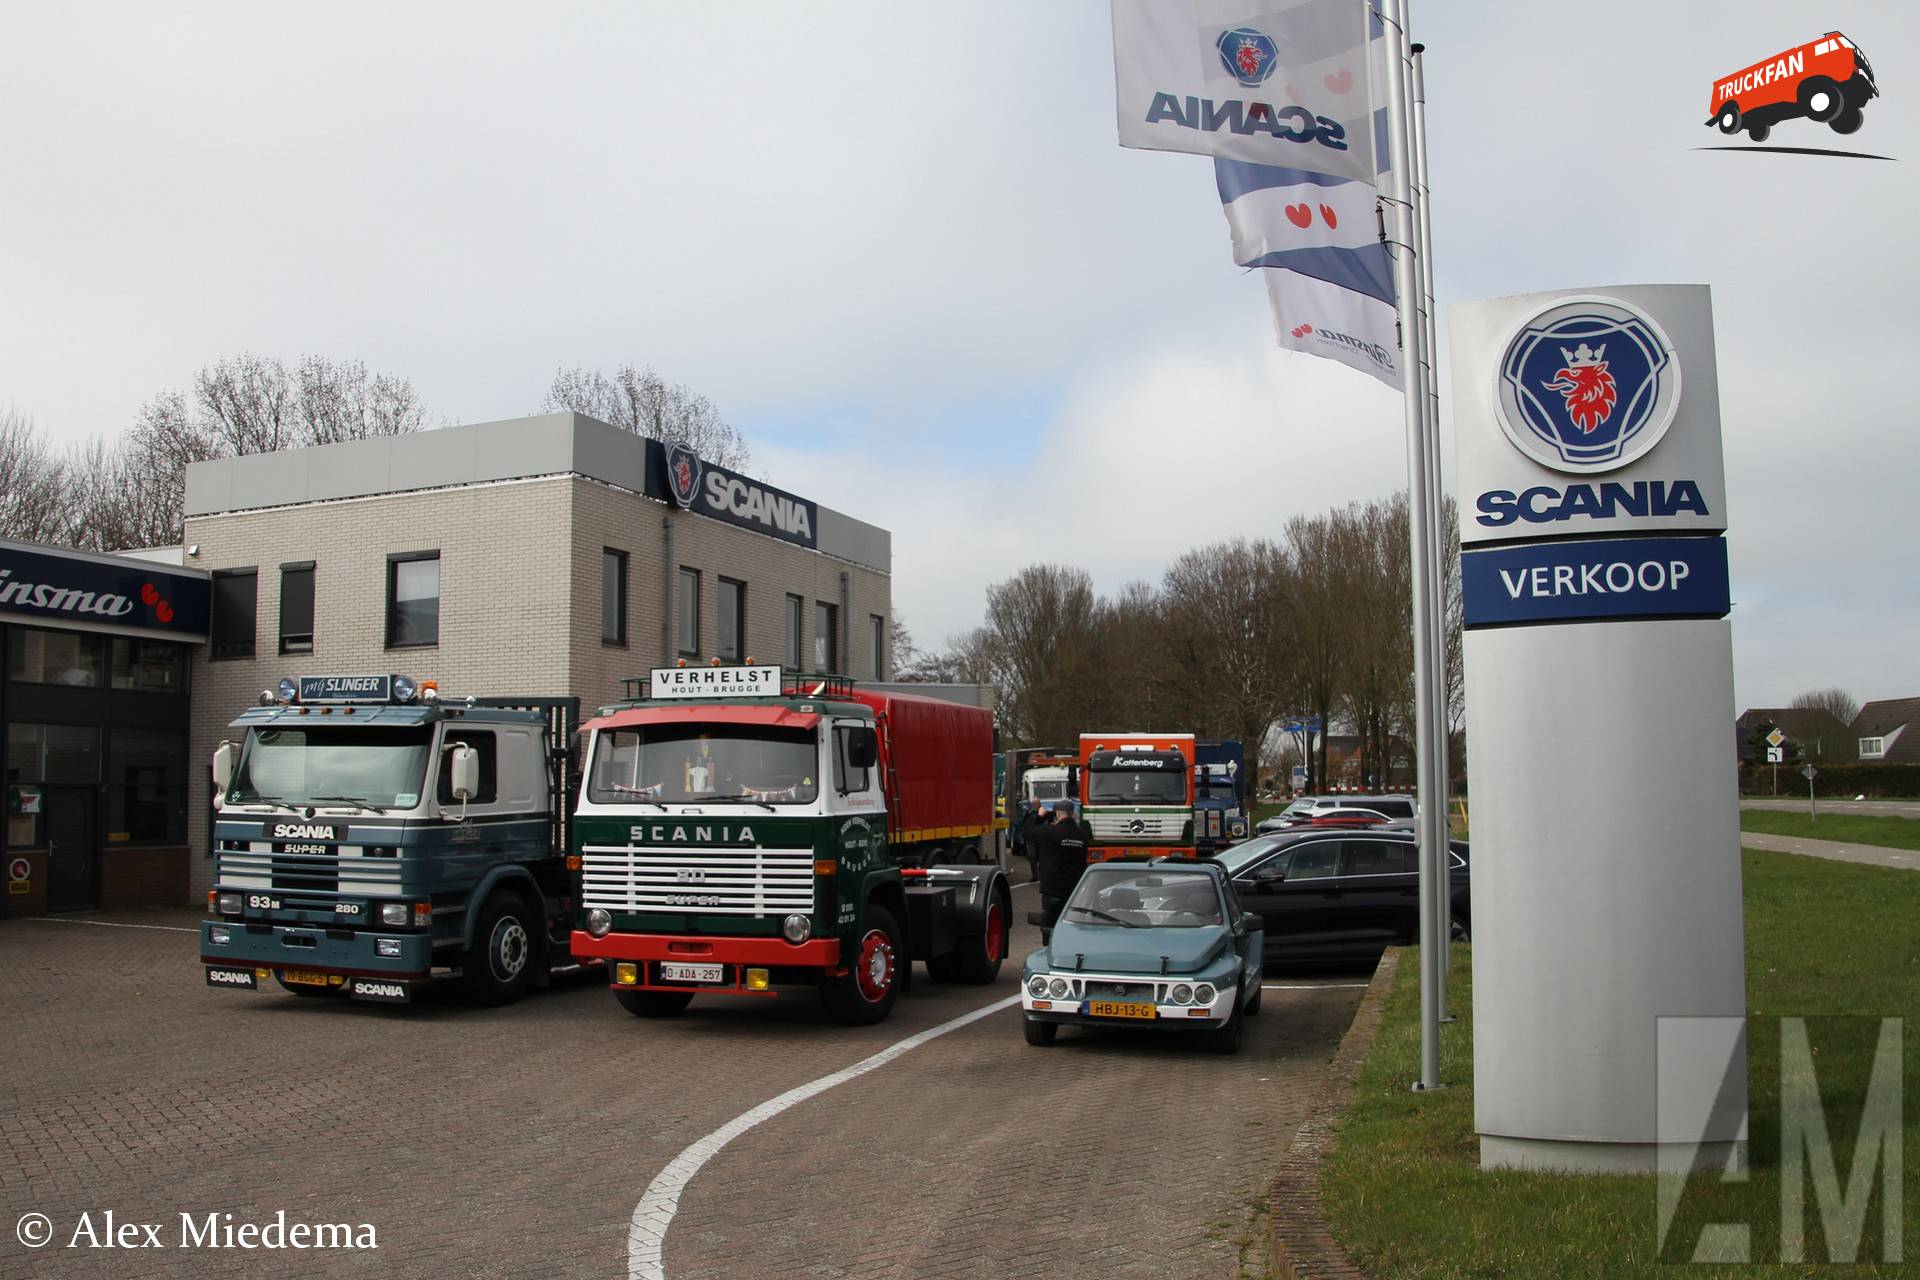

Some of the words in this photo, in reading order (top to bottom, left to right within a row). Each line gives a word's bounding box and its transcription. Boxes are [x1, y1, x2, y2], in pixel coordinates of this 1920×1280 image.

[705, 471, 812, 540] SCANIA
[1475, 480, 1710, 527] SCANIA
[1499, 560, 1690, 600] VERKOOP
[660, 670, 772, 684] VERHELST
[326, 678, 380, 692] SLINGER
[1112, 756, 1163, 768] Kattenberg
[274, 824, 334, 839] SCANIA
[630, 825, 755, 841] SCANIA
[284, 844, 326, 854] SUPER
[676, 869, 706, 883] 80
[665, 895, 720, 906] SUPER
[335, 904, 359, 914] 280
[210, 970, 252, 984] SCANIA
[354, 983, 404, 997] SCANIA
[1095, 1002, 1149, 1017] HBJ-13-G
